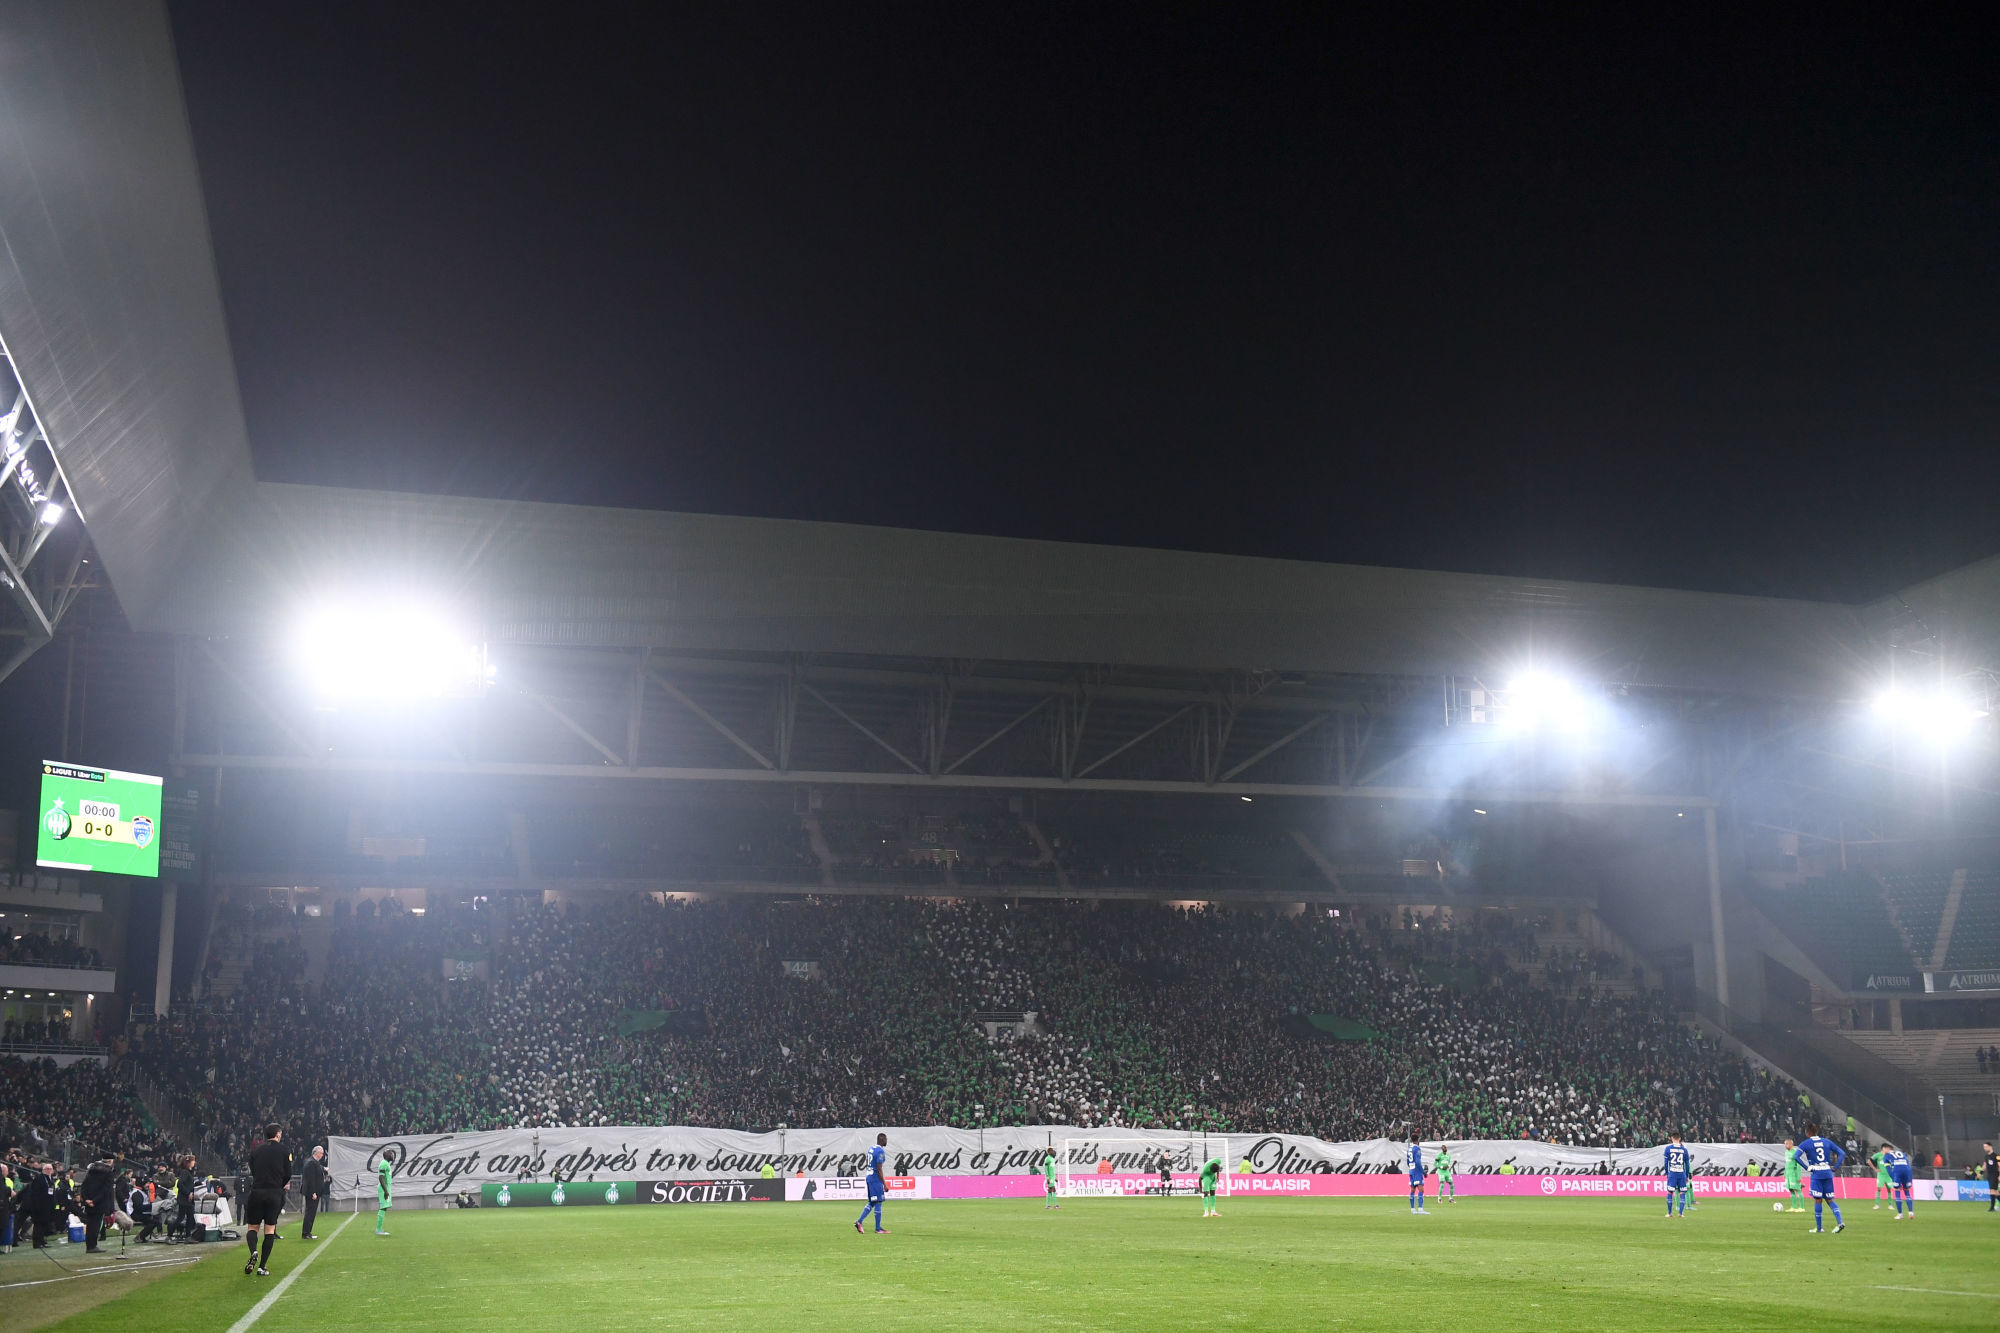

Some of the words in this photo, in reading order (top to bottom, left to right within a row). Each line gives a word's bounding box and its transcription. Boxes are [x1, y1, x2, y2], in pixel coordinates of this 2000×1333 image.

[52, 767, 72, 777] LIGUE
[84, 804, 116, 818] 00:00
[1876, 975, 1911, 988] ATRIUM
[1960, 974, 2000, 985] ATRIUM
[1670, 1152, 1684, 1164] 24
[1815, 1147, 1825, 1162] 3
[1889, 1150, 1904, 1160] 10
[366, 1135, 481, 1194] Vingt
[486, 1149, 547, 1173] ans
[555, 1143, 639, 1182] après
[646, 1148, 701, 1172] ton
[894, 1147, 963, 1170] nous
[970, 1151, 991, 1171] a
[824, 1179, 866, 1189] ABC
[1124, 1179, 1163, 1191] DOIT
[1230, 1179, 1250, 1191] UN
[1252, 1179, 1311, 1191] PLAISIR
[1561, 1180, 1614, 1192] PARIER
[1616, 1180, 1651, 1192] DOIT
[1712, 1181, 1733, 1193] UN
[1735, 1181, 1790, 1193] PLAISIR
[651, 1181, 754, 1203] SOCIETY
